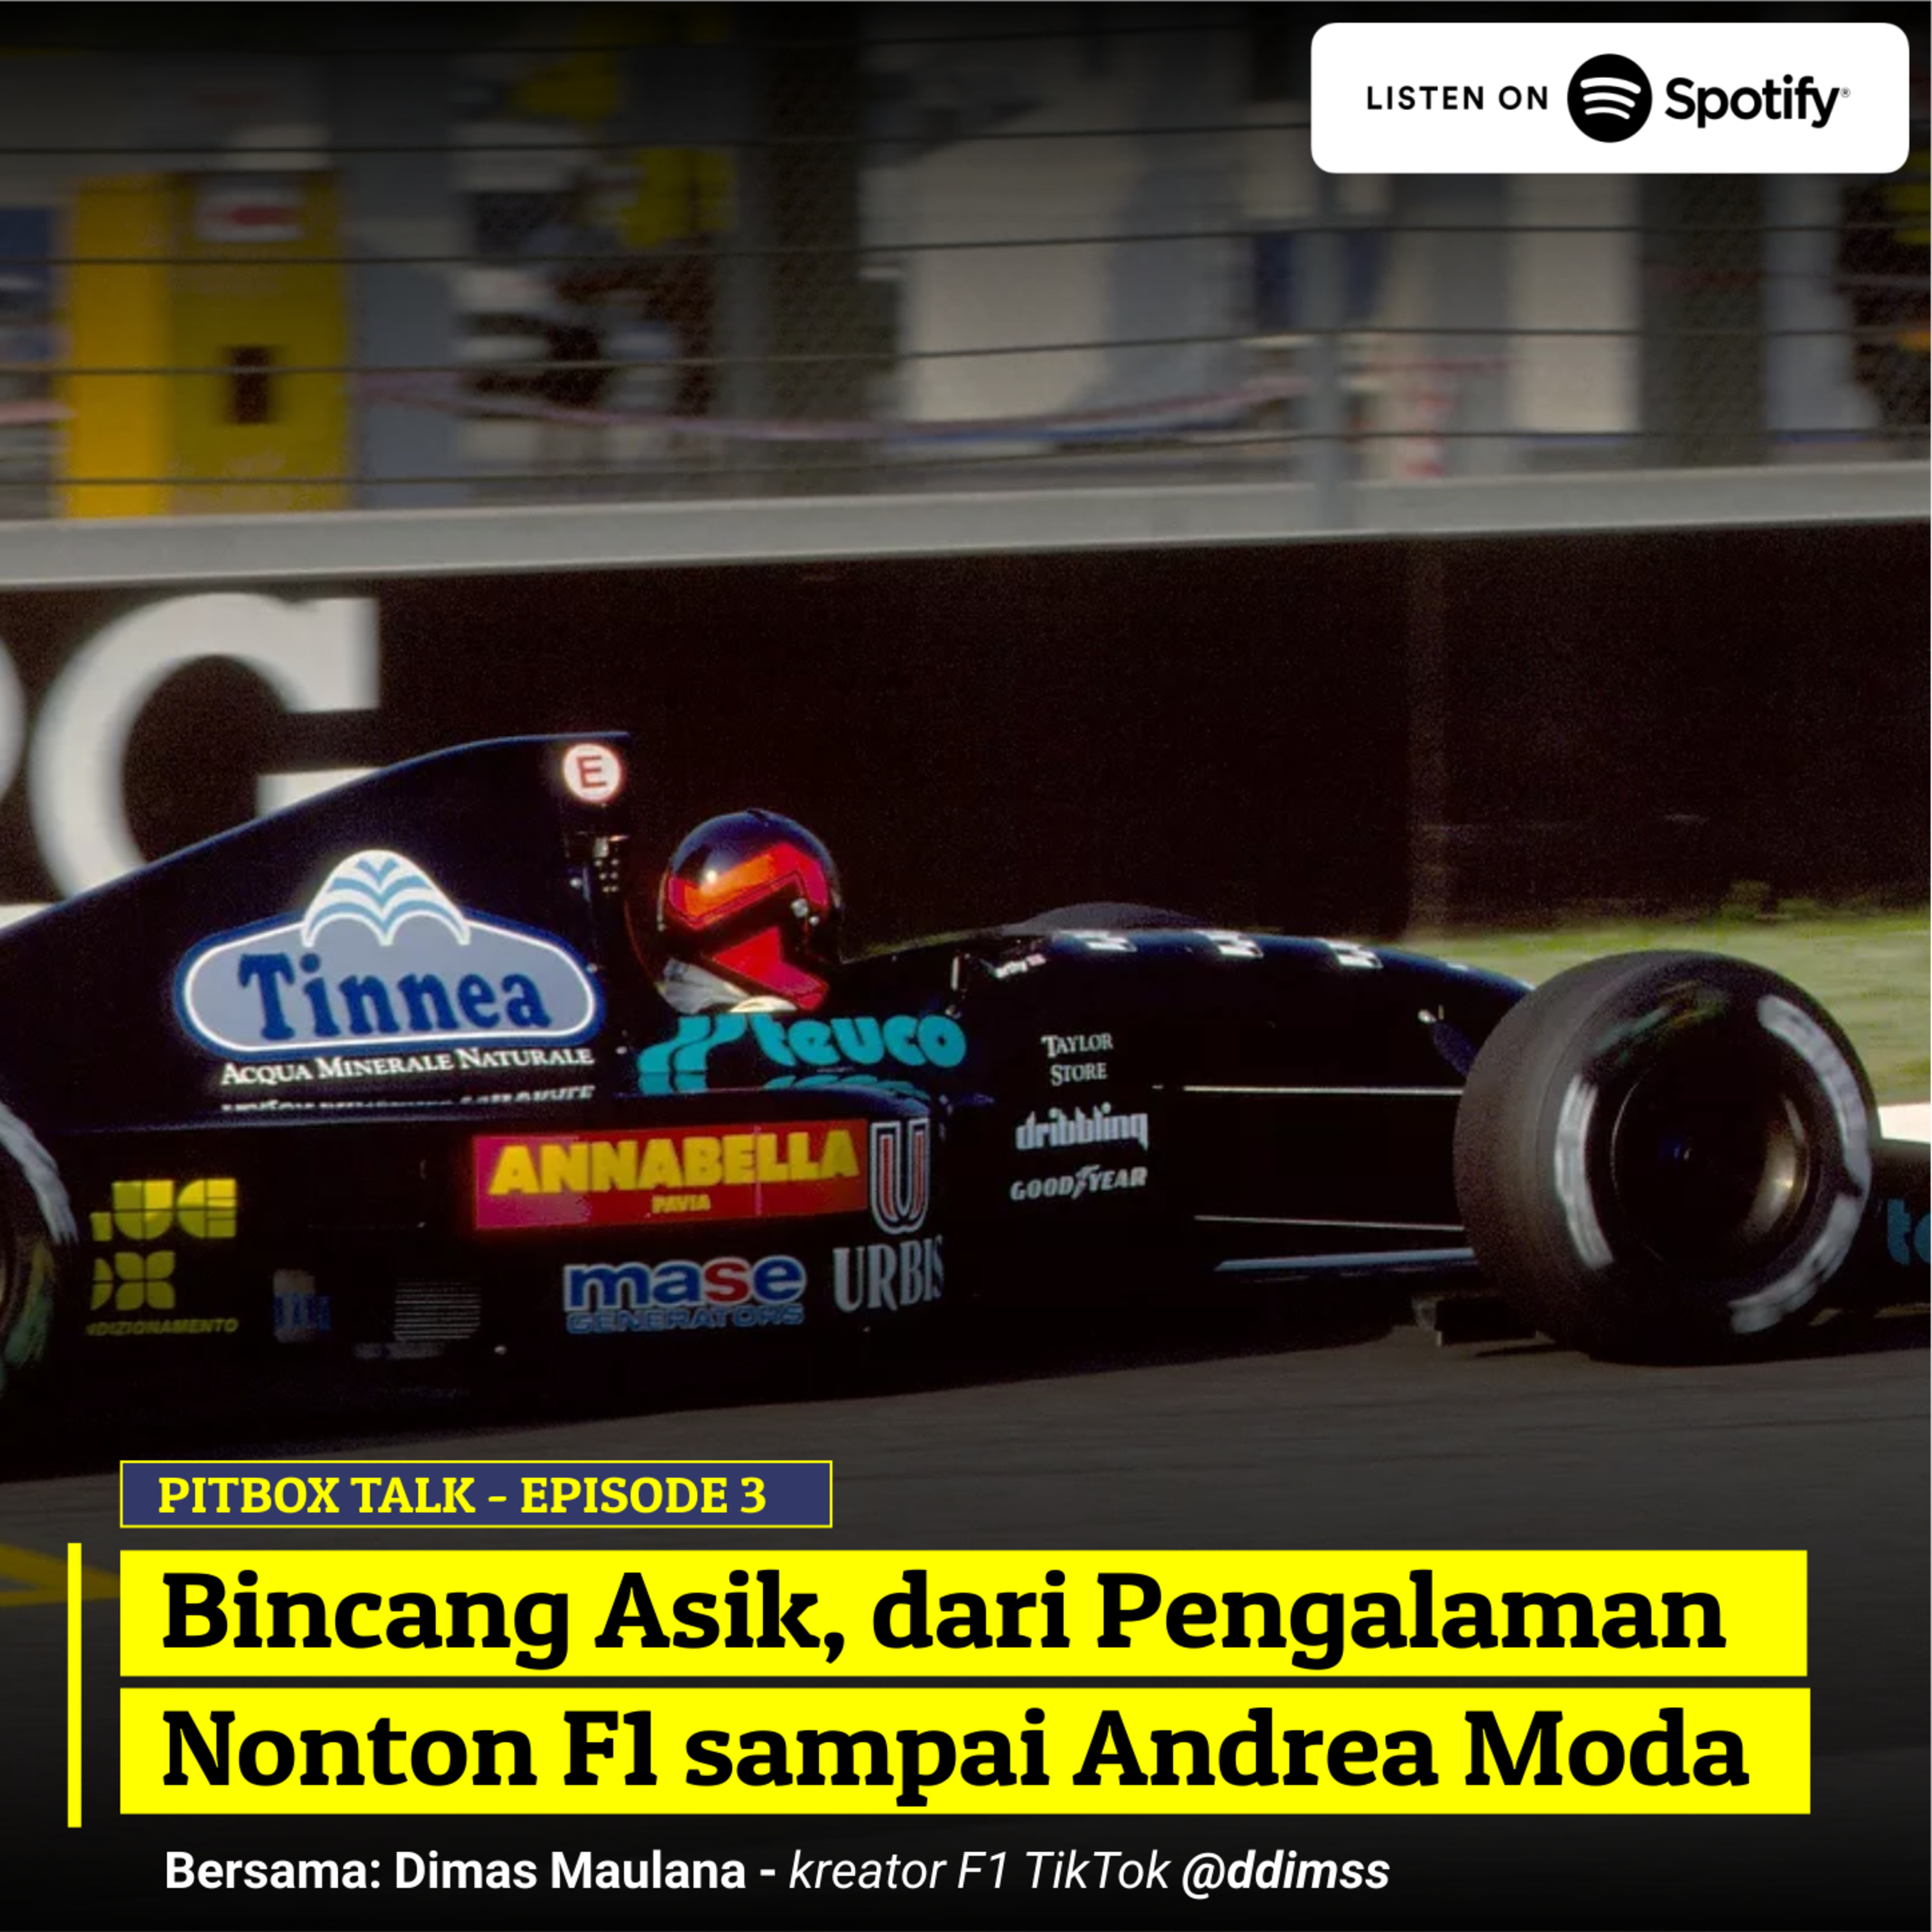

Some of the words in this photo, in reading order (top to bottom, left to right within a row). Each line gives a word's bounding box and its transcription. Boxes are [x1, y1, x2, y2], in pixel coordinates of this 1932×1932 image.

[576, 755, 607, 788] E
[238, 953, 553, 1040] Tinnea
[752, 1014, 966, 1067] teuco
[1041, 1033, 1113, 1058] TAYLOR
[221, 1062, 308, 1086] ACQUA
[317, 1052, 453, 1080] MINERALE
[457, 1046, 595, 1072] NATURALE
[1051, 1062, 1108, 1086] STORE
[1016, 1102, 1148, 1150] dribbling
[488, 1130, 860, 1196] ANNABELLA
[1010, 1165, 1148, 1200] GOODYEAR
[652, 1194, 712, 1214] PAVIA
[564, 1255, 807, 1312] mase
[566, 1302, 804, 1335] GENERATORS
